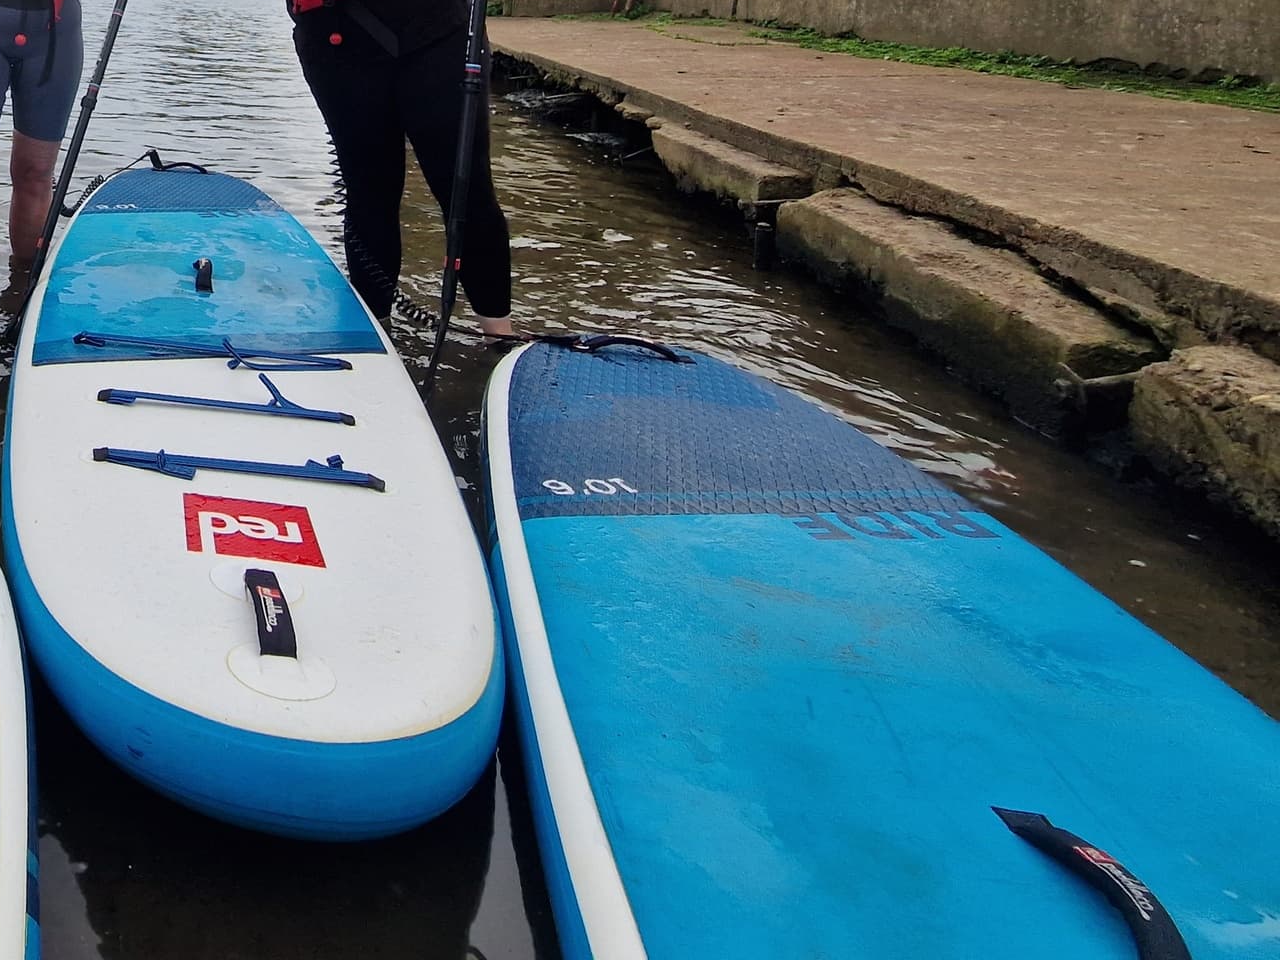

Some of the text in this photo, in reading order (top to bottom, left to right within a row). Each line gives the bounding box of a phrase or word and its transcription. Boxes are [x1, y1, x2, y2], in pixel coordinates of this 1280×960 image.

[542, 477, 638, 496] 10'6
[198, 511, 303, 552] red
[791, 511, 1003, 540] RIDE
